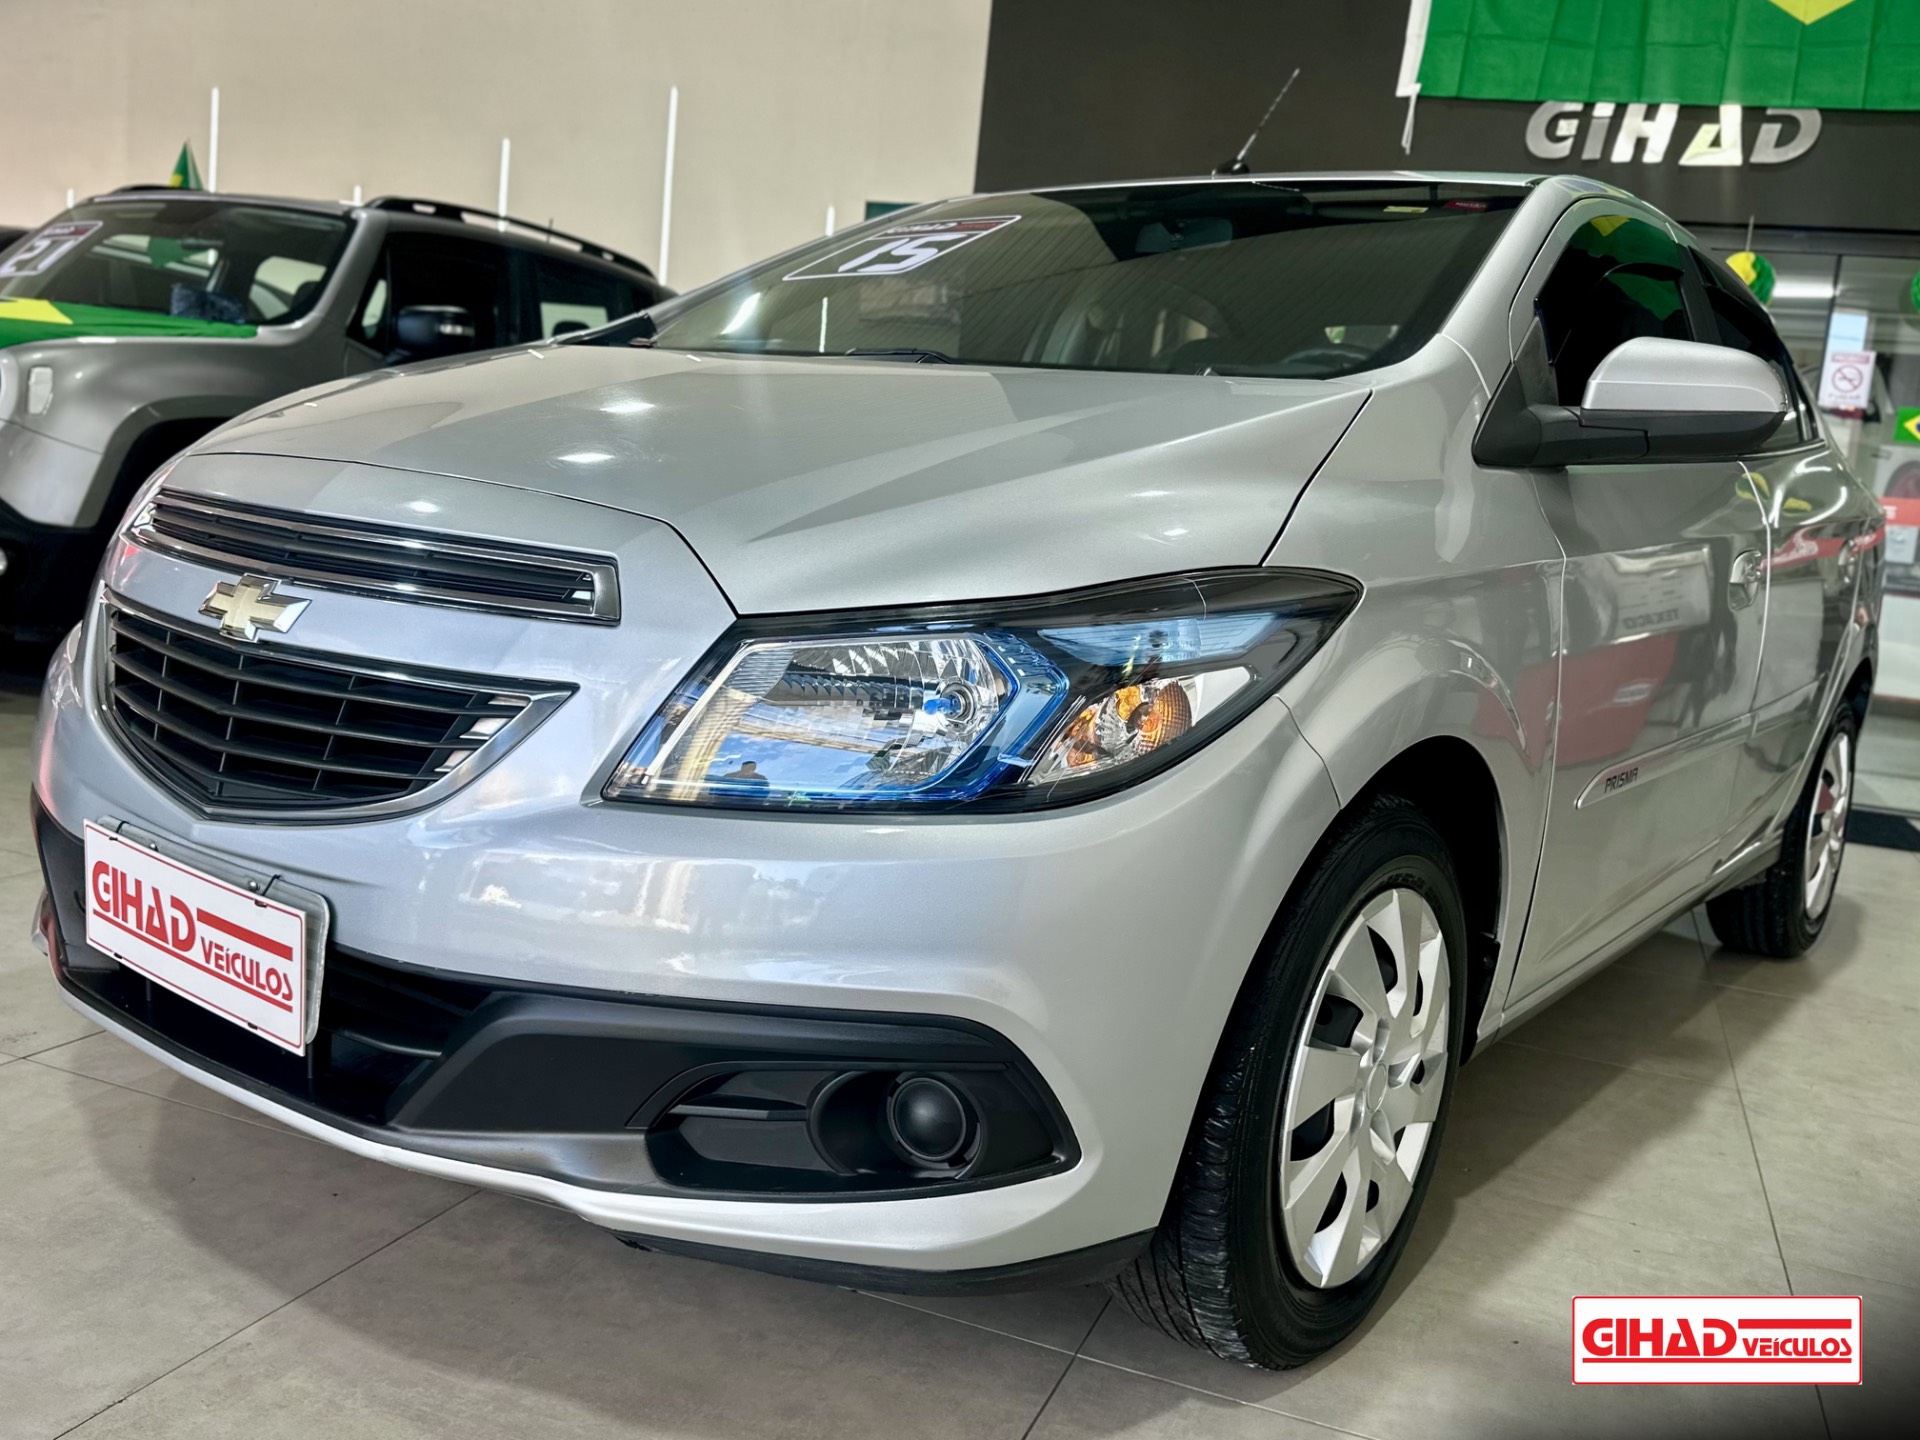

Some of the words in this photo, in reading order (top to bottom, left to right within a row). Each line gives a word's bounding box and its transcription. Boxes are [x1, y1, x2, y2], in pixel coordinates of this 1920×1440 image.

[0, 239, 77, 274] 21
[837, 233, 968, 273] 15
[1604, 767, 1639, 794] PRISMA
[92, 860, 197, 953] GIHAD
